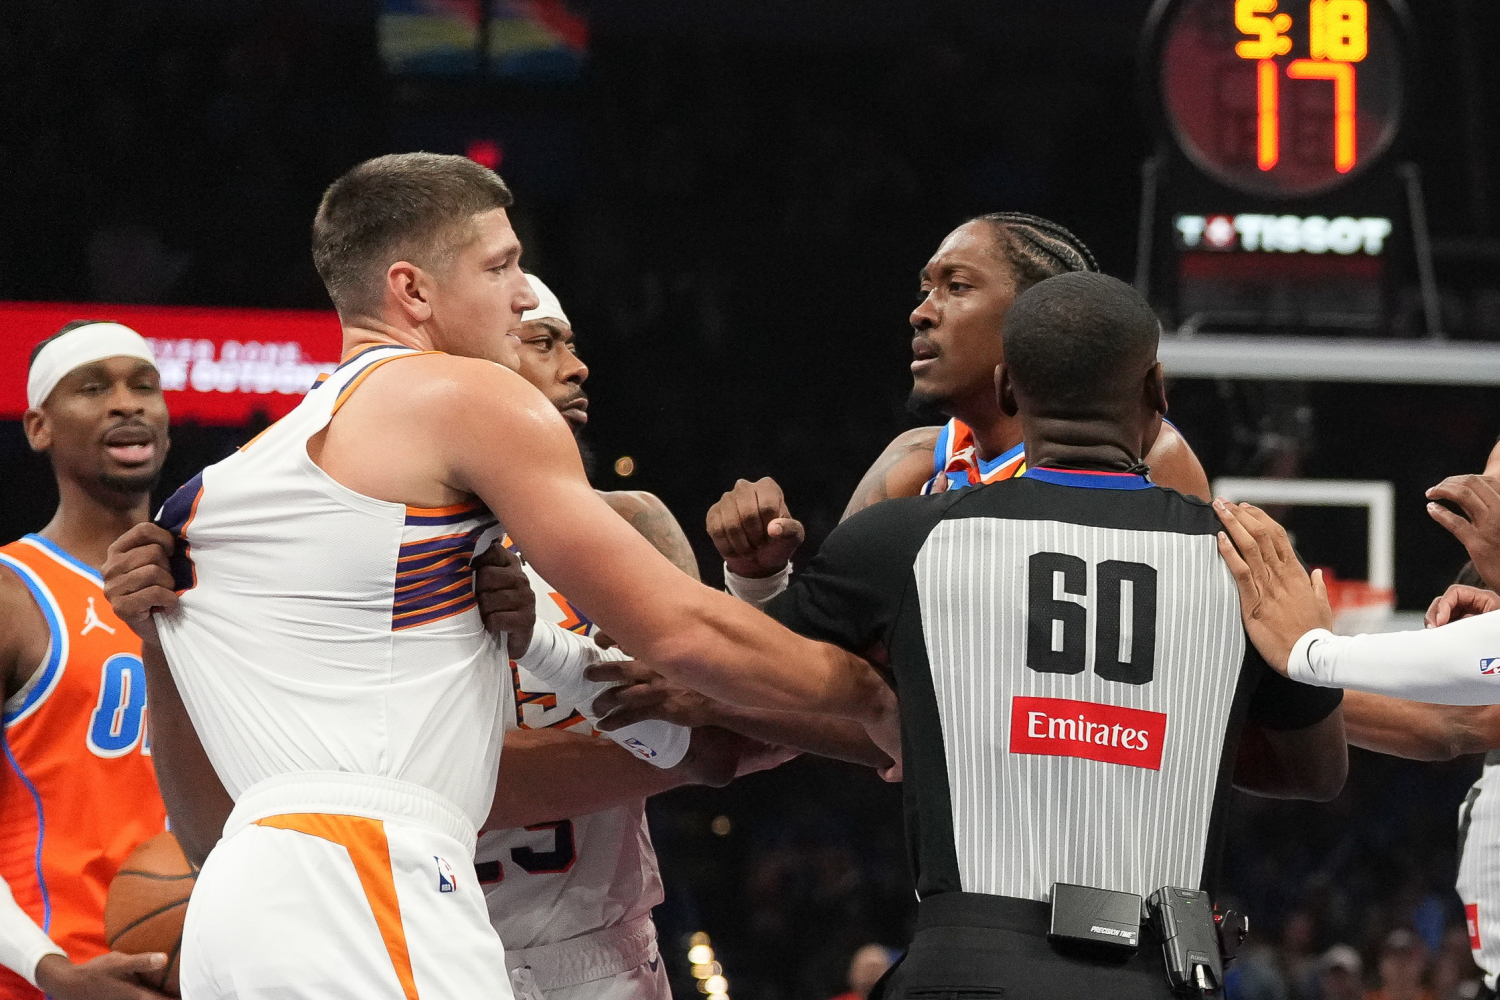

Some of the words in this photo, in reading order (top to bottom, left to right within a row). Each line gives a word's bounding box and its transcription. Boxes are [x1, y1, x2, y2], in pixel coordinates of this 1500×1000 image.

[1235, 0, 1368, 62] 5:18
[1256, 59, 1356, 173] 17
[1234, 213, 1392, 255] TISSOT
[1026, 551, 1158, 685] 60
[1027, 710, 1149, 751] Emirates
